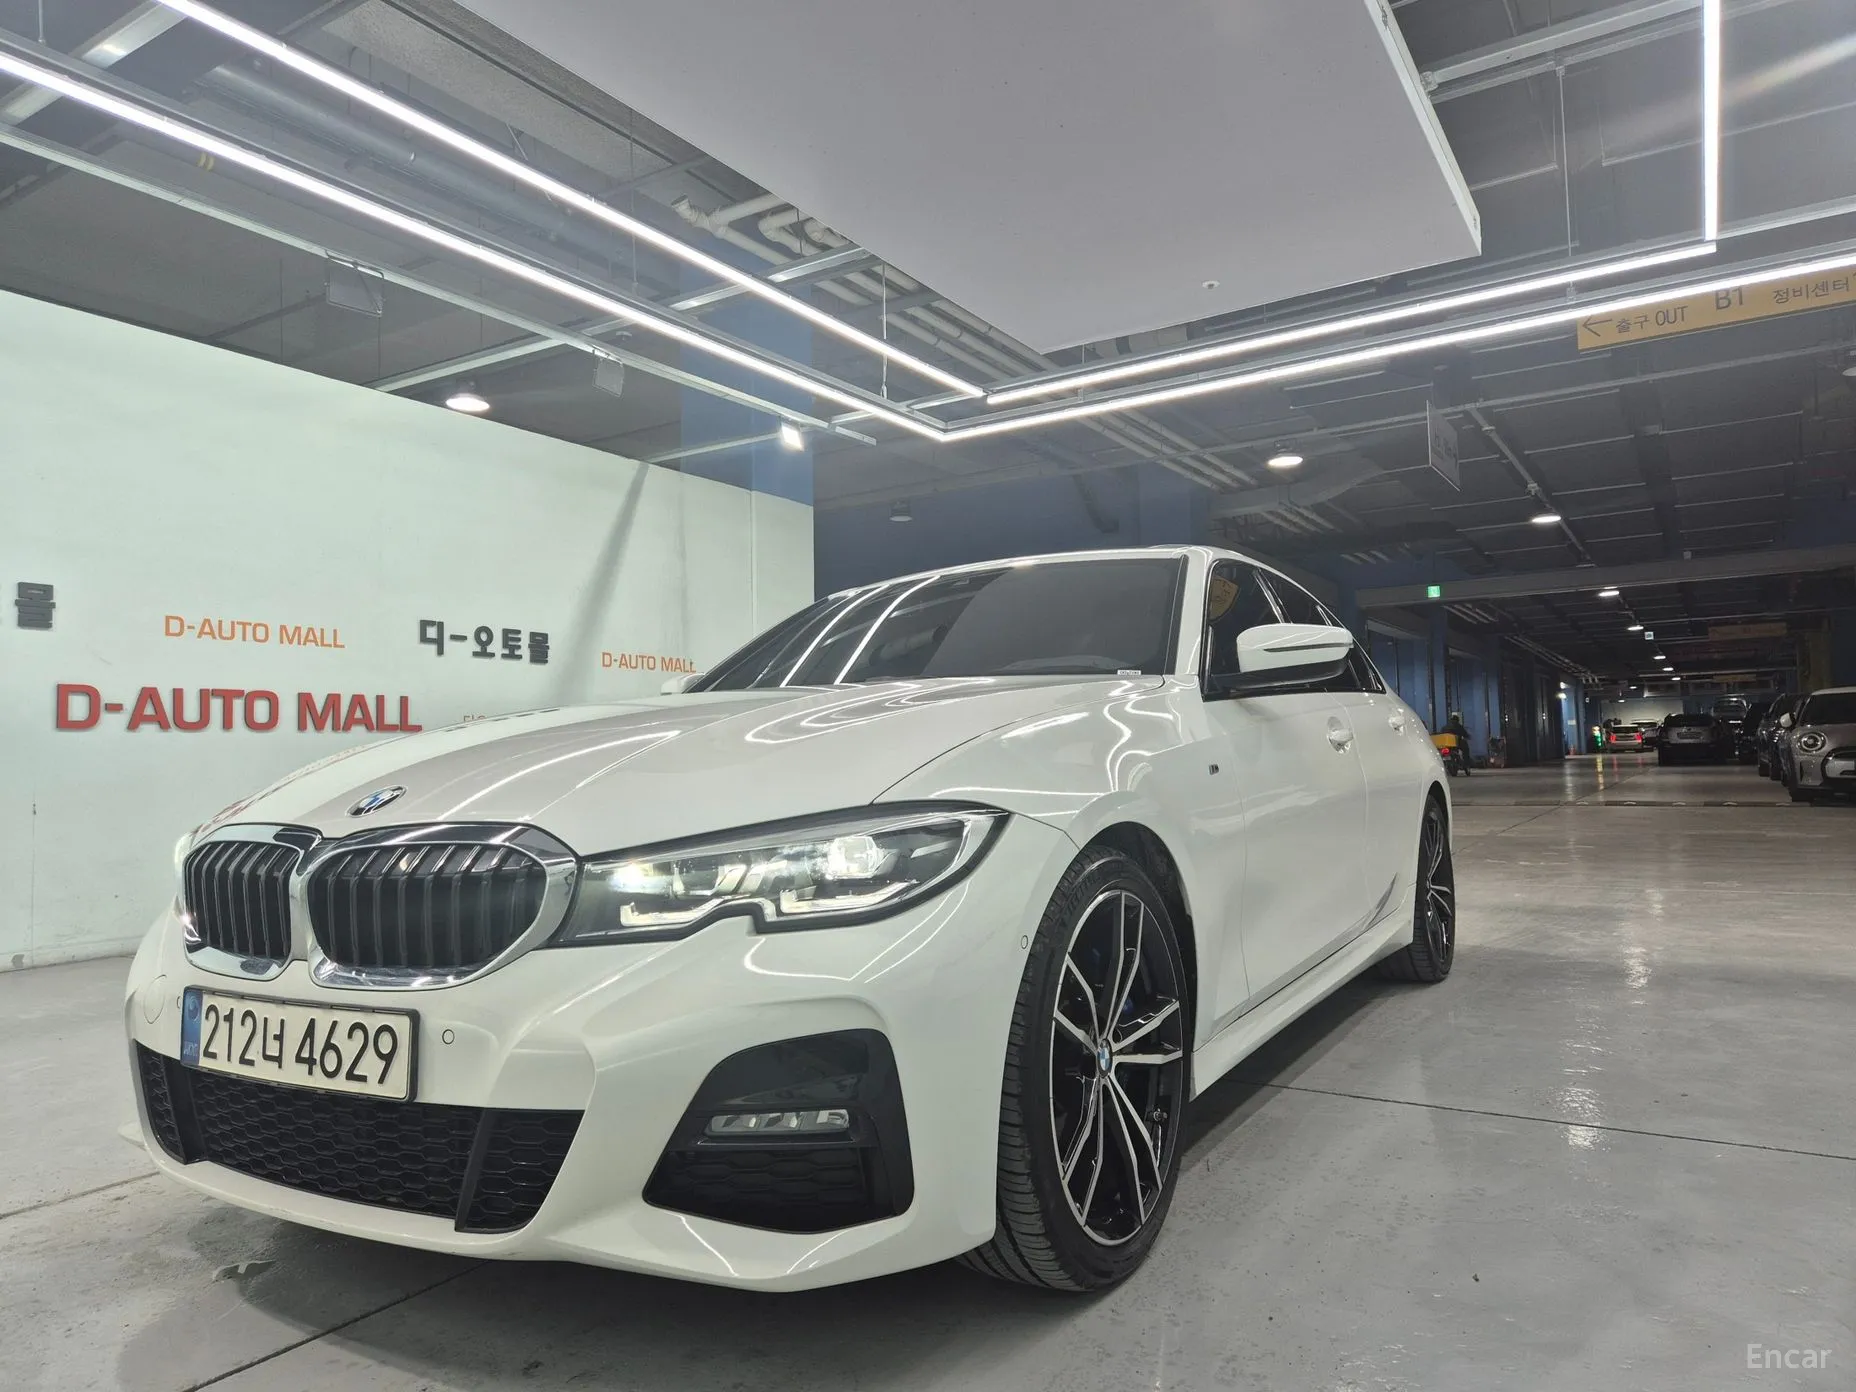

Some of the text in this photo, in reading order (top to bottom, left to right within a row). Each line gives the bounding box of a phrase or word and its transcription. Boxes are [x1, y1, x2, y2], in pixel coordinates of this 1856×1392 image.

[1714, 287, 1744, 312] B1
[1773, 276, 1850, 305] 정비센터
[1616, 305, 1689, 334] 출구 OUT
[165, 615, 346, 649] D-AUTO MALL
[419, 619, 550, 665] 디-오토몰
[602, 652, 697, 673] D-AUTO MALL
[56, 683, 423, 732] D-AUTO MALL
[203, 1004, 398, 1085] 212너 4629
